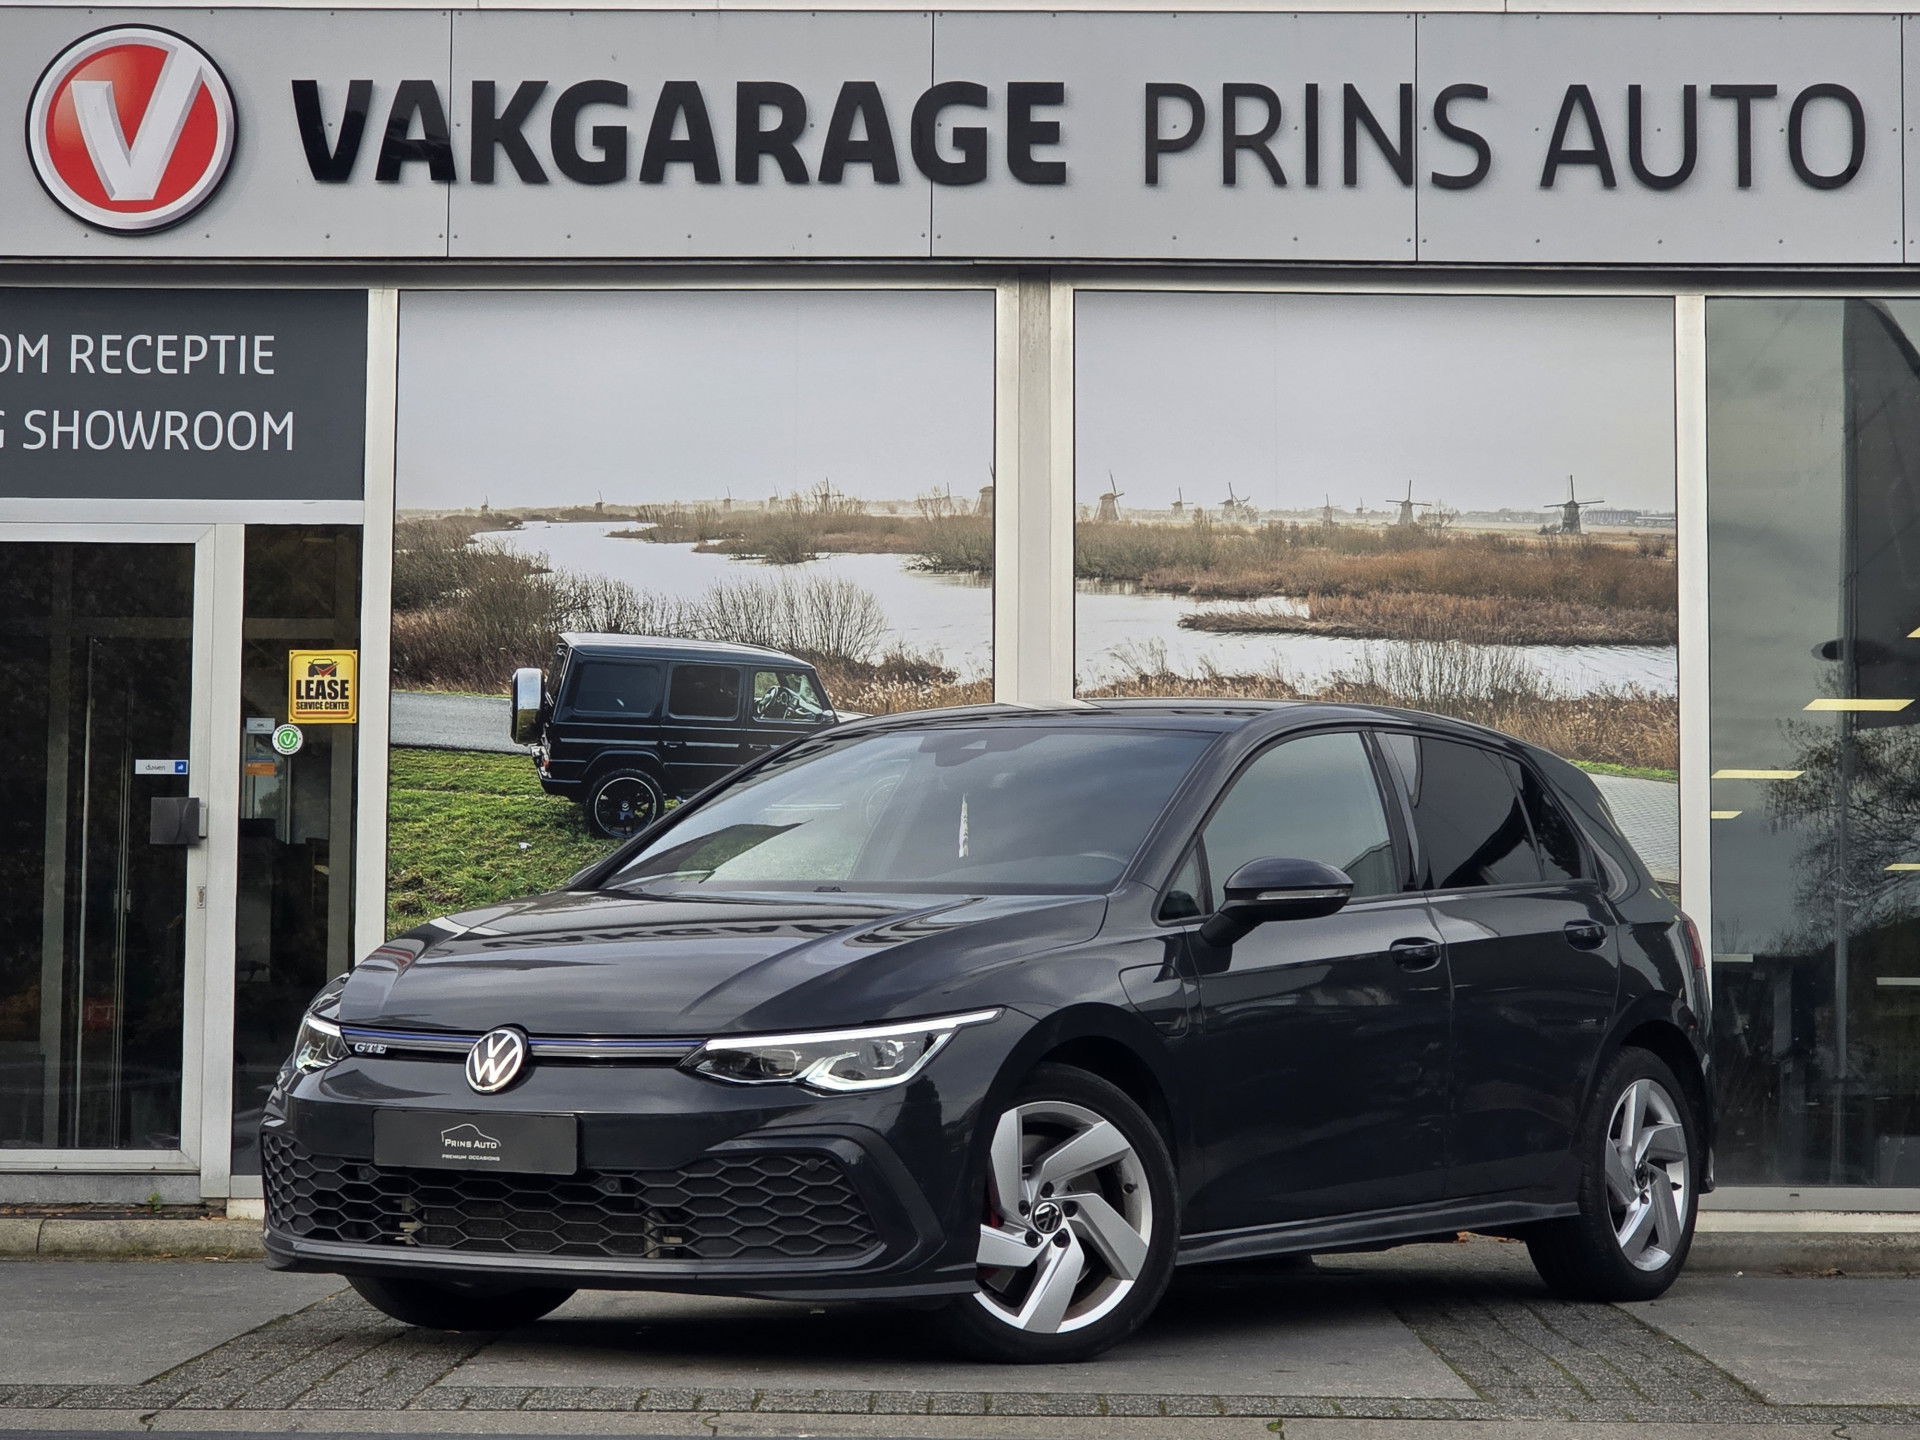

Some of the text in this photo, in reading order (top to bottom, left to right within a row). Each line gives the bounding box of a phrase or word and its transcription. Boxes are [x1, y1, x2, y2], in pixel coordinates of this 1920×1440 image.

[291, 79, 1867, 191] VAKGARAGE PRINS AUTO
[70, 333, 275, 375] RECEPTIE
[22, 409, 294, 451] SHOWROOM
[295, 679, 350, 700] LEASE
[295, 701, 350, 710] SERVICE CENTER
[354, 1042, 388, 1054] GTE
[468, 1154, 501, 1162] OCCASIONS
